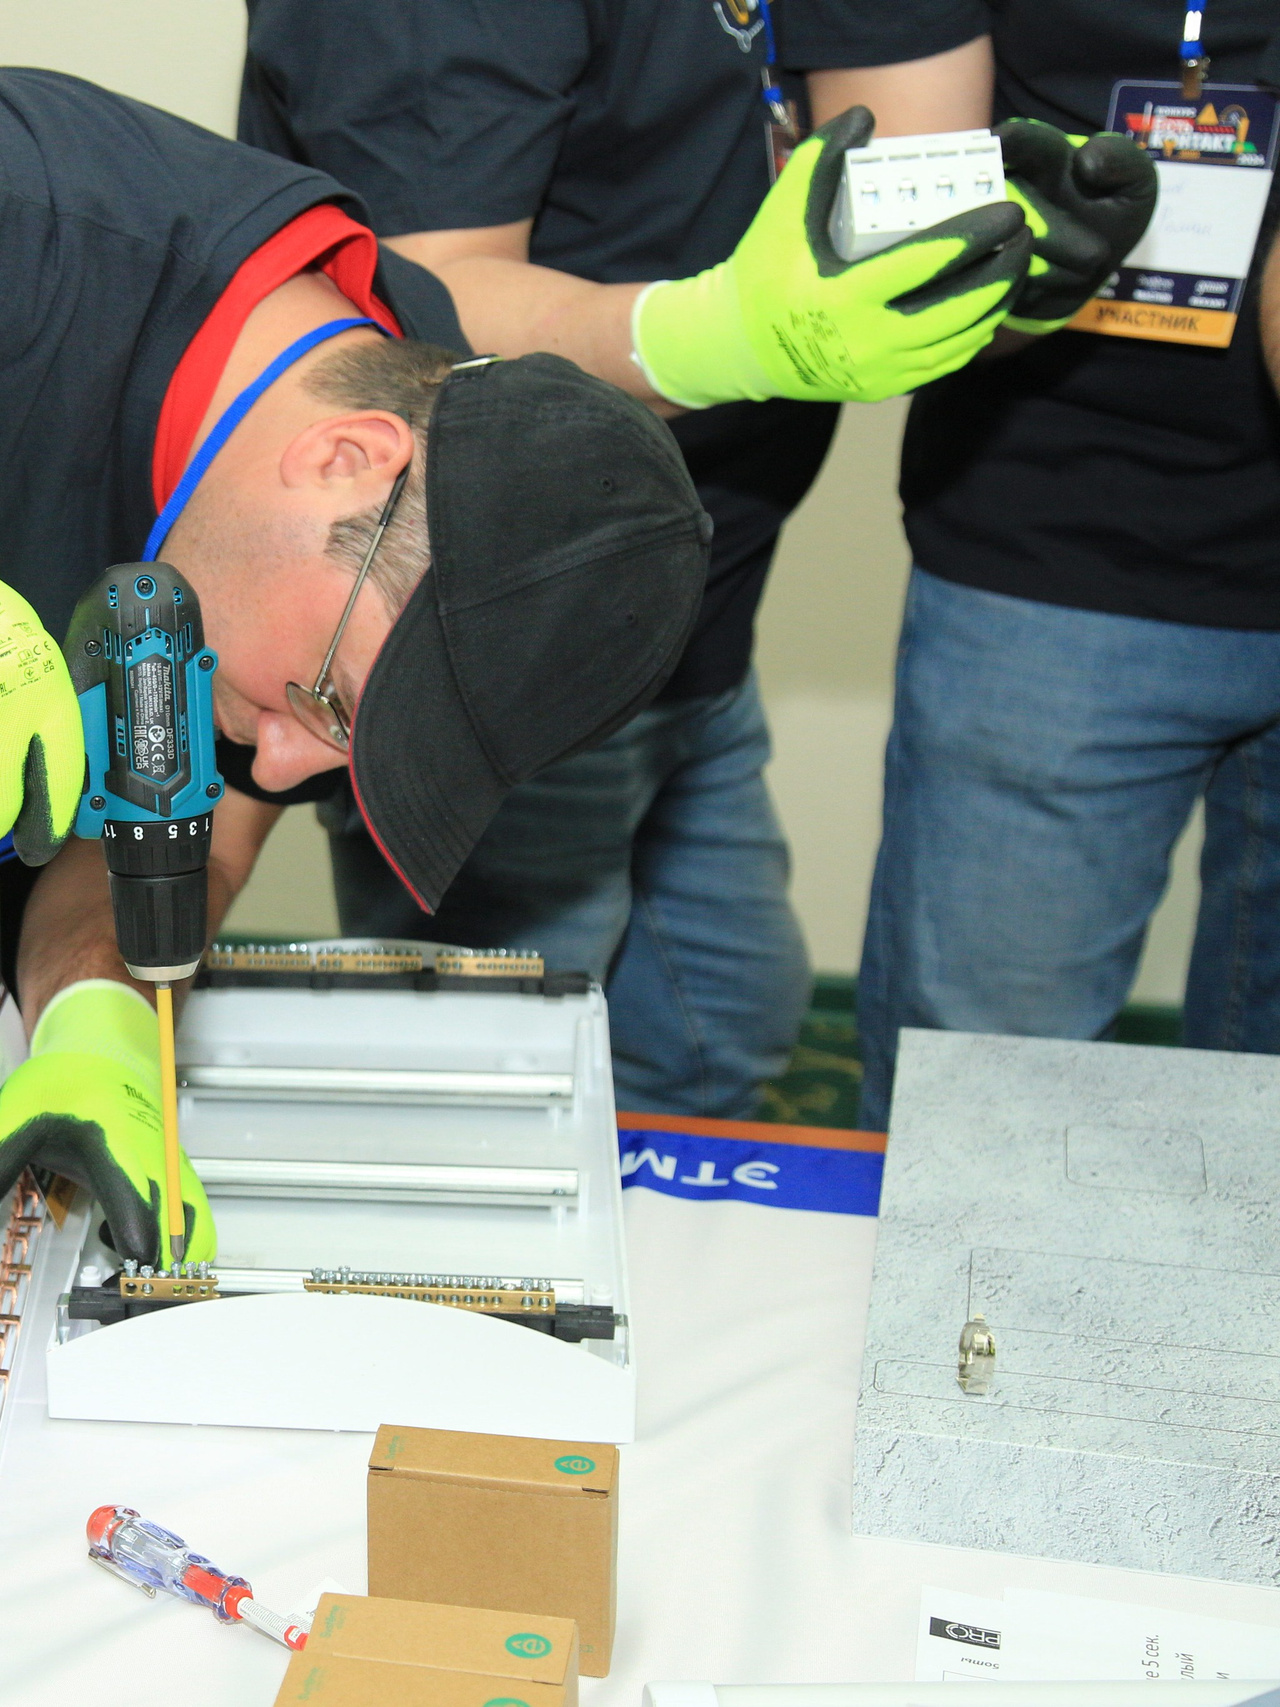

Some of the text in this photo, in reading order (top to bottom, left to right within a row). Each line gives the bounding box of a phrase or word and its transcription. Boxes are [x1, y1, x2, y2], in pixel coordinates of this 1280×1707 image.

[1095, 305, 1201, 333] УЧАСТНИК
[133, 825, 144, 841] 8
[168, 824, 179, 840] 5
[189, 820, 198, 836] 3
[621, 1148, 780, 1190] ЭТМ
[1145, 1635, 1159, 1658] сек.
[1141, 1660, 1159, 1668] 5
